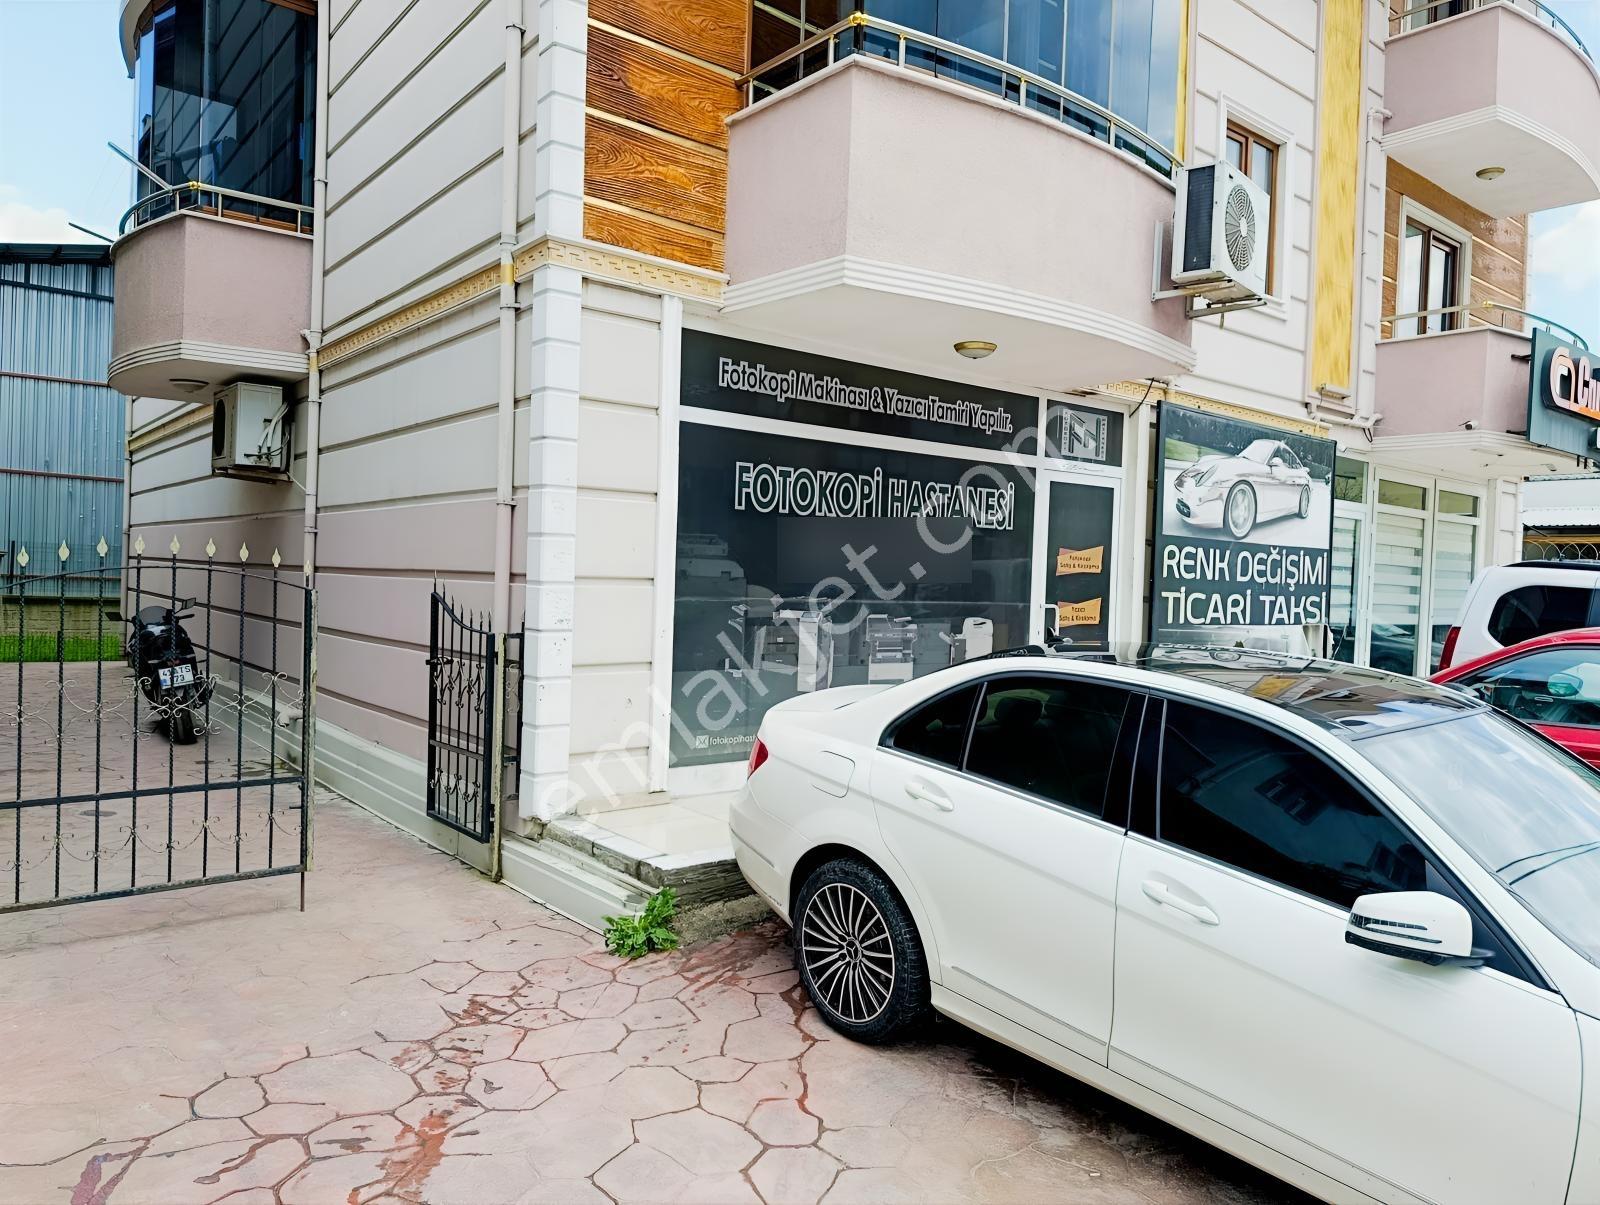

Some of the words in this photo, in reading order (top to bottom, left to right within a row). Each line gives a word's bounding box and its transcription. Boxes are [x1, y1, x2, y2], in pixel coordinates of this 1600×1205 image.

[719, 357, 797, 402] Fotokopi
[797, 372, 869, 411] Makinası
[870, 386, 885, 413] &
[884, 387, 928, 420] Yazıcı
[928, 395, 970, 426] Tamiri
[969, 402, 1013, 435] Yapılır.
[735, 461, 882, 518] FOTOKOPİ
[888, 478, 1016, 530] HASTANESİ
[1162, 544, 1231, 582] RENK
[1236, 546, 1328, 591] DEĞİŞİMİ
[1161, 586, 1251, 626] TİCARİ
[1260, 591, 1328, 626] TAKSİ
